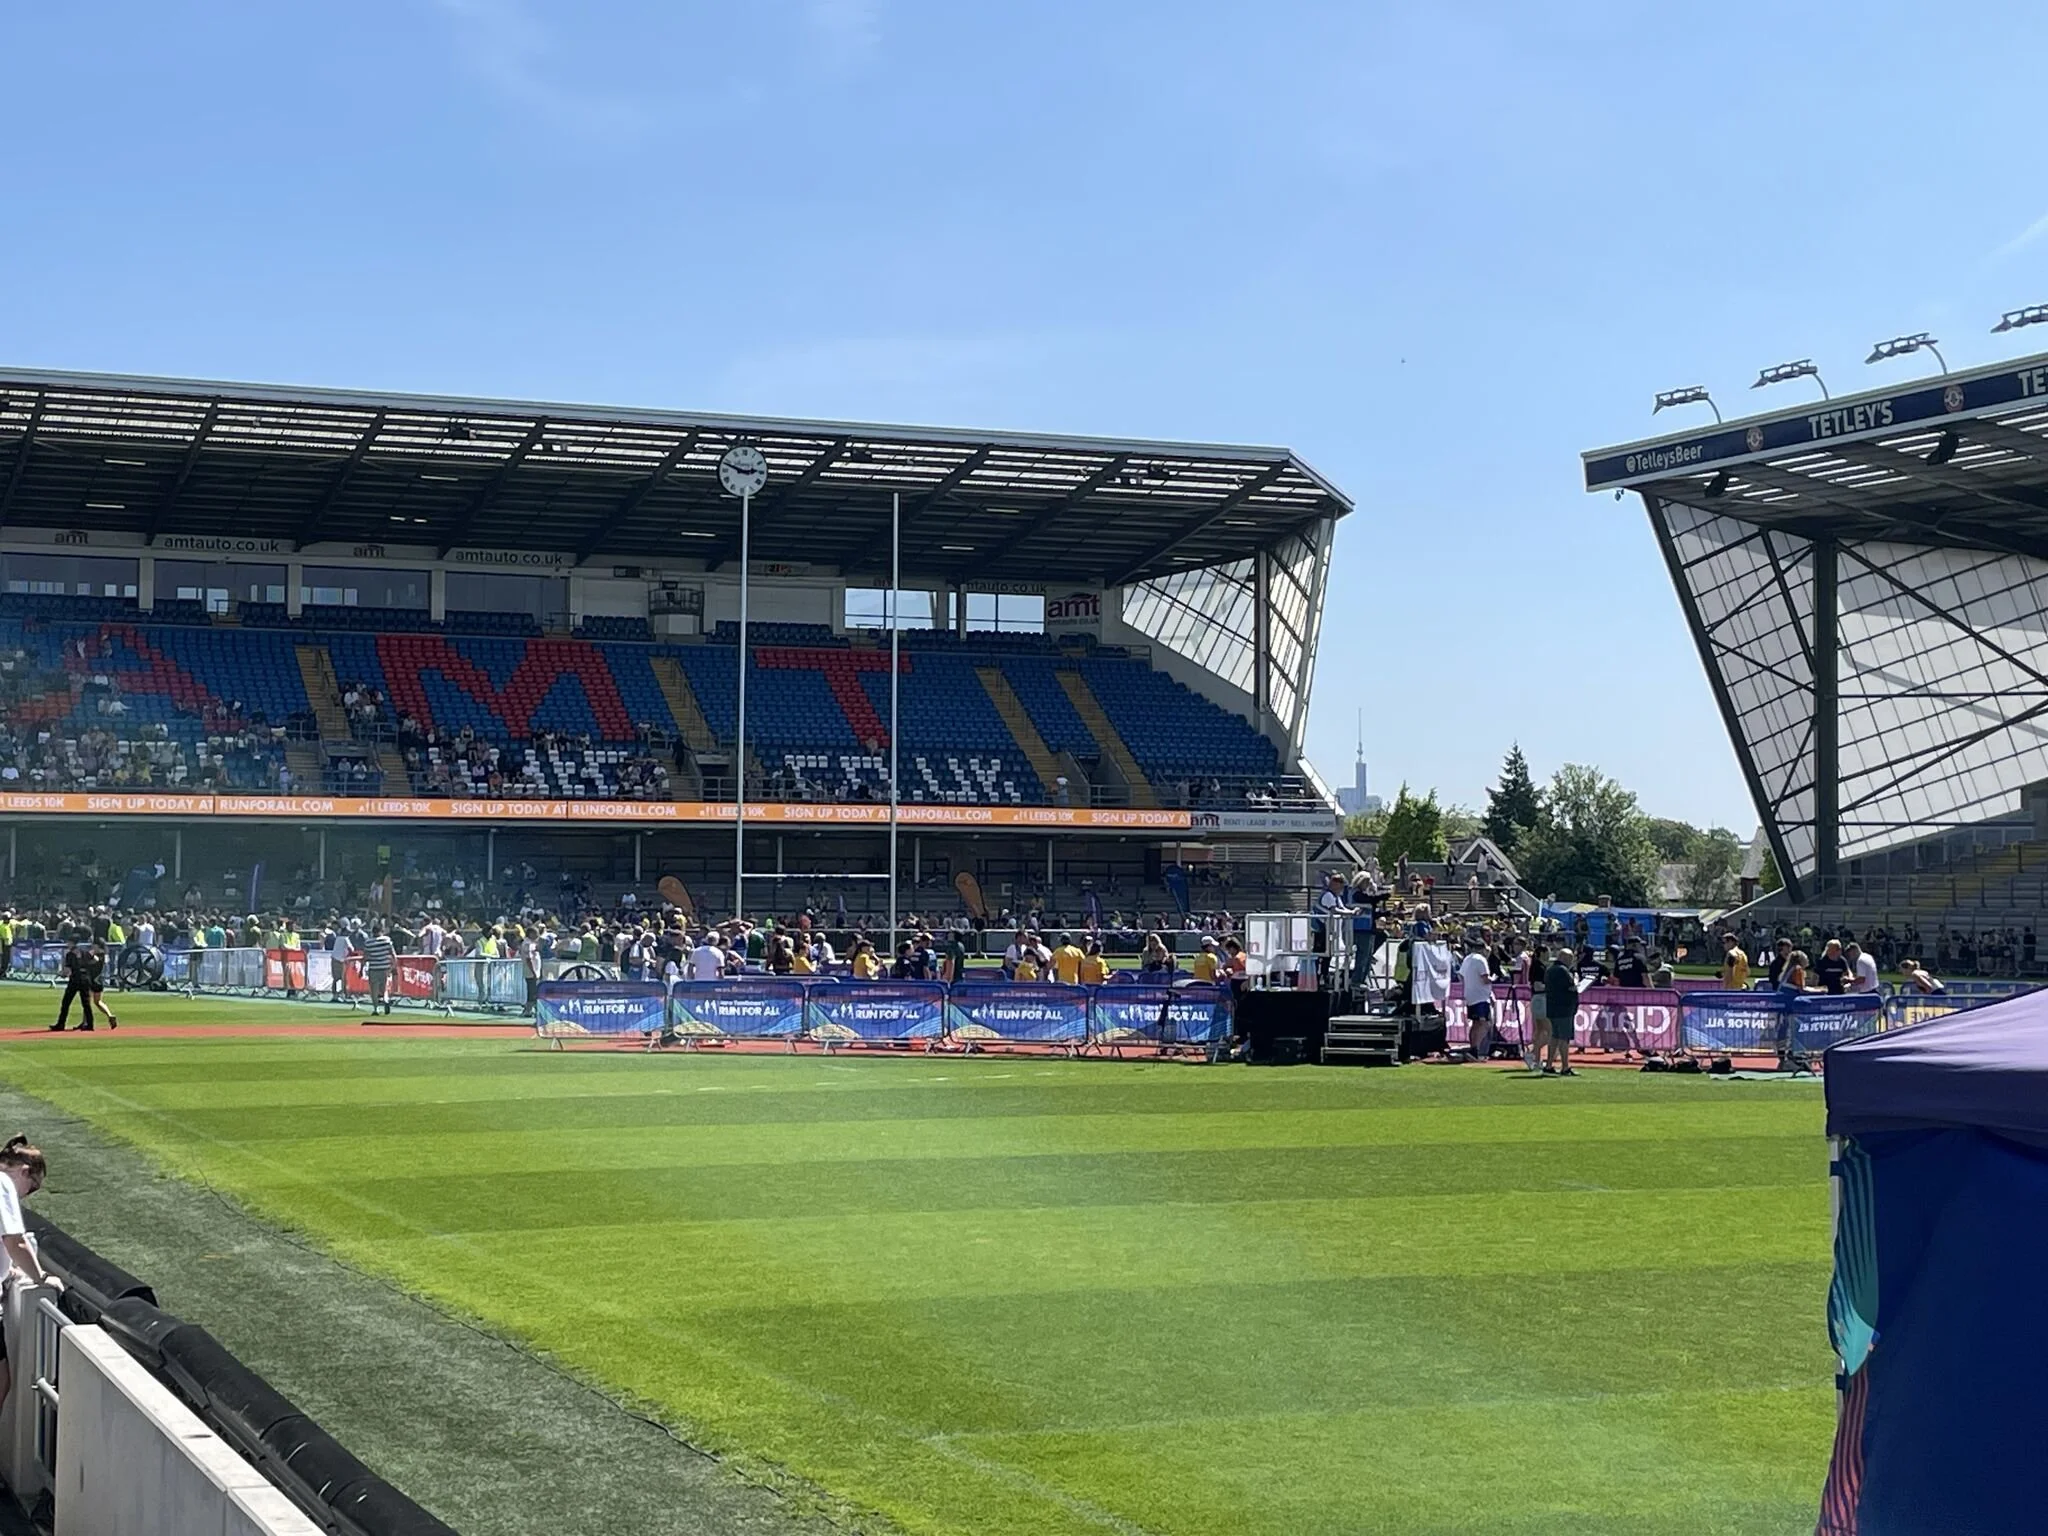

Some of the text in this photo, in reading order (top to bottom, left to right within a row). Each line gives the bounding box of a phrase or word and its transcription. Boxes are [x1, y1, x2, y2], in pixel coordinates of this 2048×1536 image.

[1807, 400, 1894, 439] TETLEY'S
[1625, 444, 1703, 473] @TetleysBeer
[54, 530, 89, 545] amt
[164, 536, 280, 553] amtauto.co.uk
[353, 544, 386, 558] amt
[456, 549, 563, 565] amtauto.co.uk
[1047, 593, 1101, 618] amt
[8, 796, 42, 808] LEEDS
[44, 796, 65, 808] 10K
[88, 797, 122, 809] SIGN
[127, 797, 146, 810] UP
[150, 798, 193, 811] TODAY
[199, 798, 214, 811] AT
[220, 799, 334, 812] RUNFORALL.COM
[377, 802, 409, 813] LEEDS
[411, 802, 431, 813] 10K
[451, 803, 483, 814] SIGN
[487, 803, 503, 815] UP
[507, 803, 548, 815] TODAY
[553, 804, 568, 815] AT
[572, 804, 677, 817] RUNFORALL.COM
[747, 806, 766, 817] 10K
[784, 807, 815, 819] SIGN
[817, 808, 833, 820] UP
[836, 808, 874, 820] TODAY
[878, 808, 891, 820] AT
[895, 808, 993, 821] RUNFORALL.COM
[1029, 810, 1057, 821] LEEDS
[1091, 811, 1119, 823] SIGN
[1122, 812, 1138, 824] UP
[1140, 812, 1175, 824] TODAY
[1191, 812, 1220, 826] amt
[583, 1004, 645, 1014] RUN FOR ALL
[719, 1006, 781, 1016] RUN FOR ALL
[855, 1009, 878, 1020] RUN
[879, 1009, 900, 1020] FOR
[996, 1009, 1064, 1020] RUN FOR ALL
[1168, 1011, 1190, 1021] FOR
[1191, 1011, 1210, 1021] ALL
